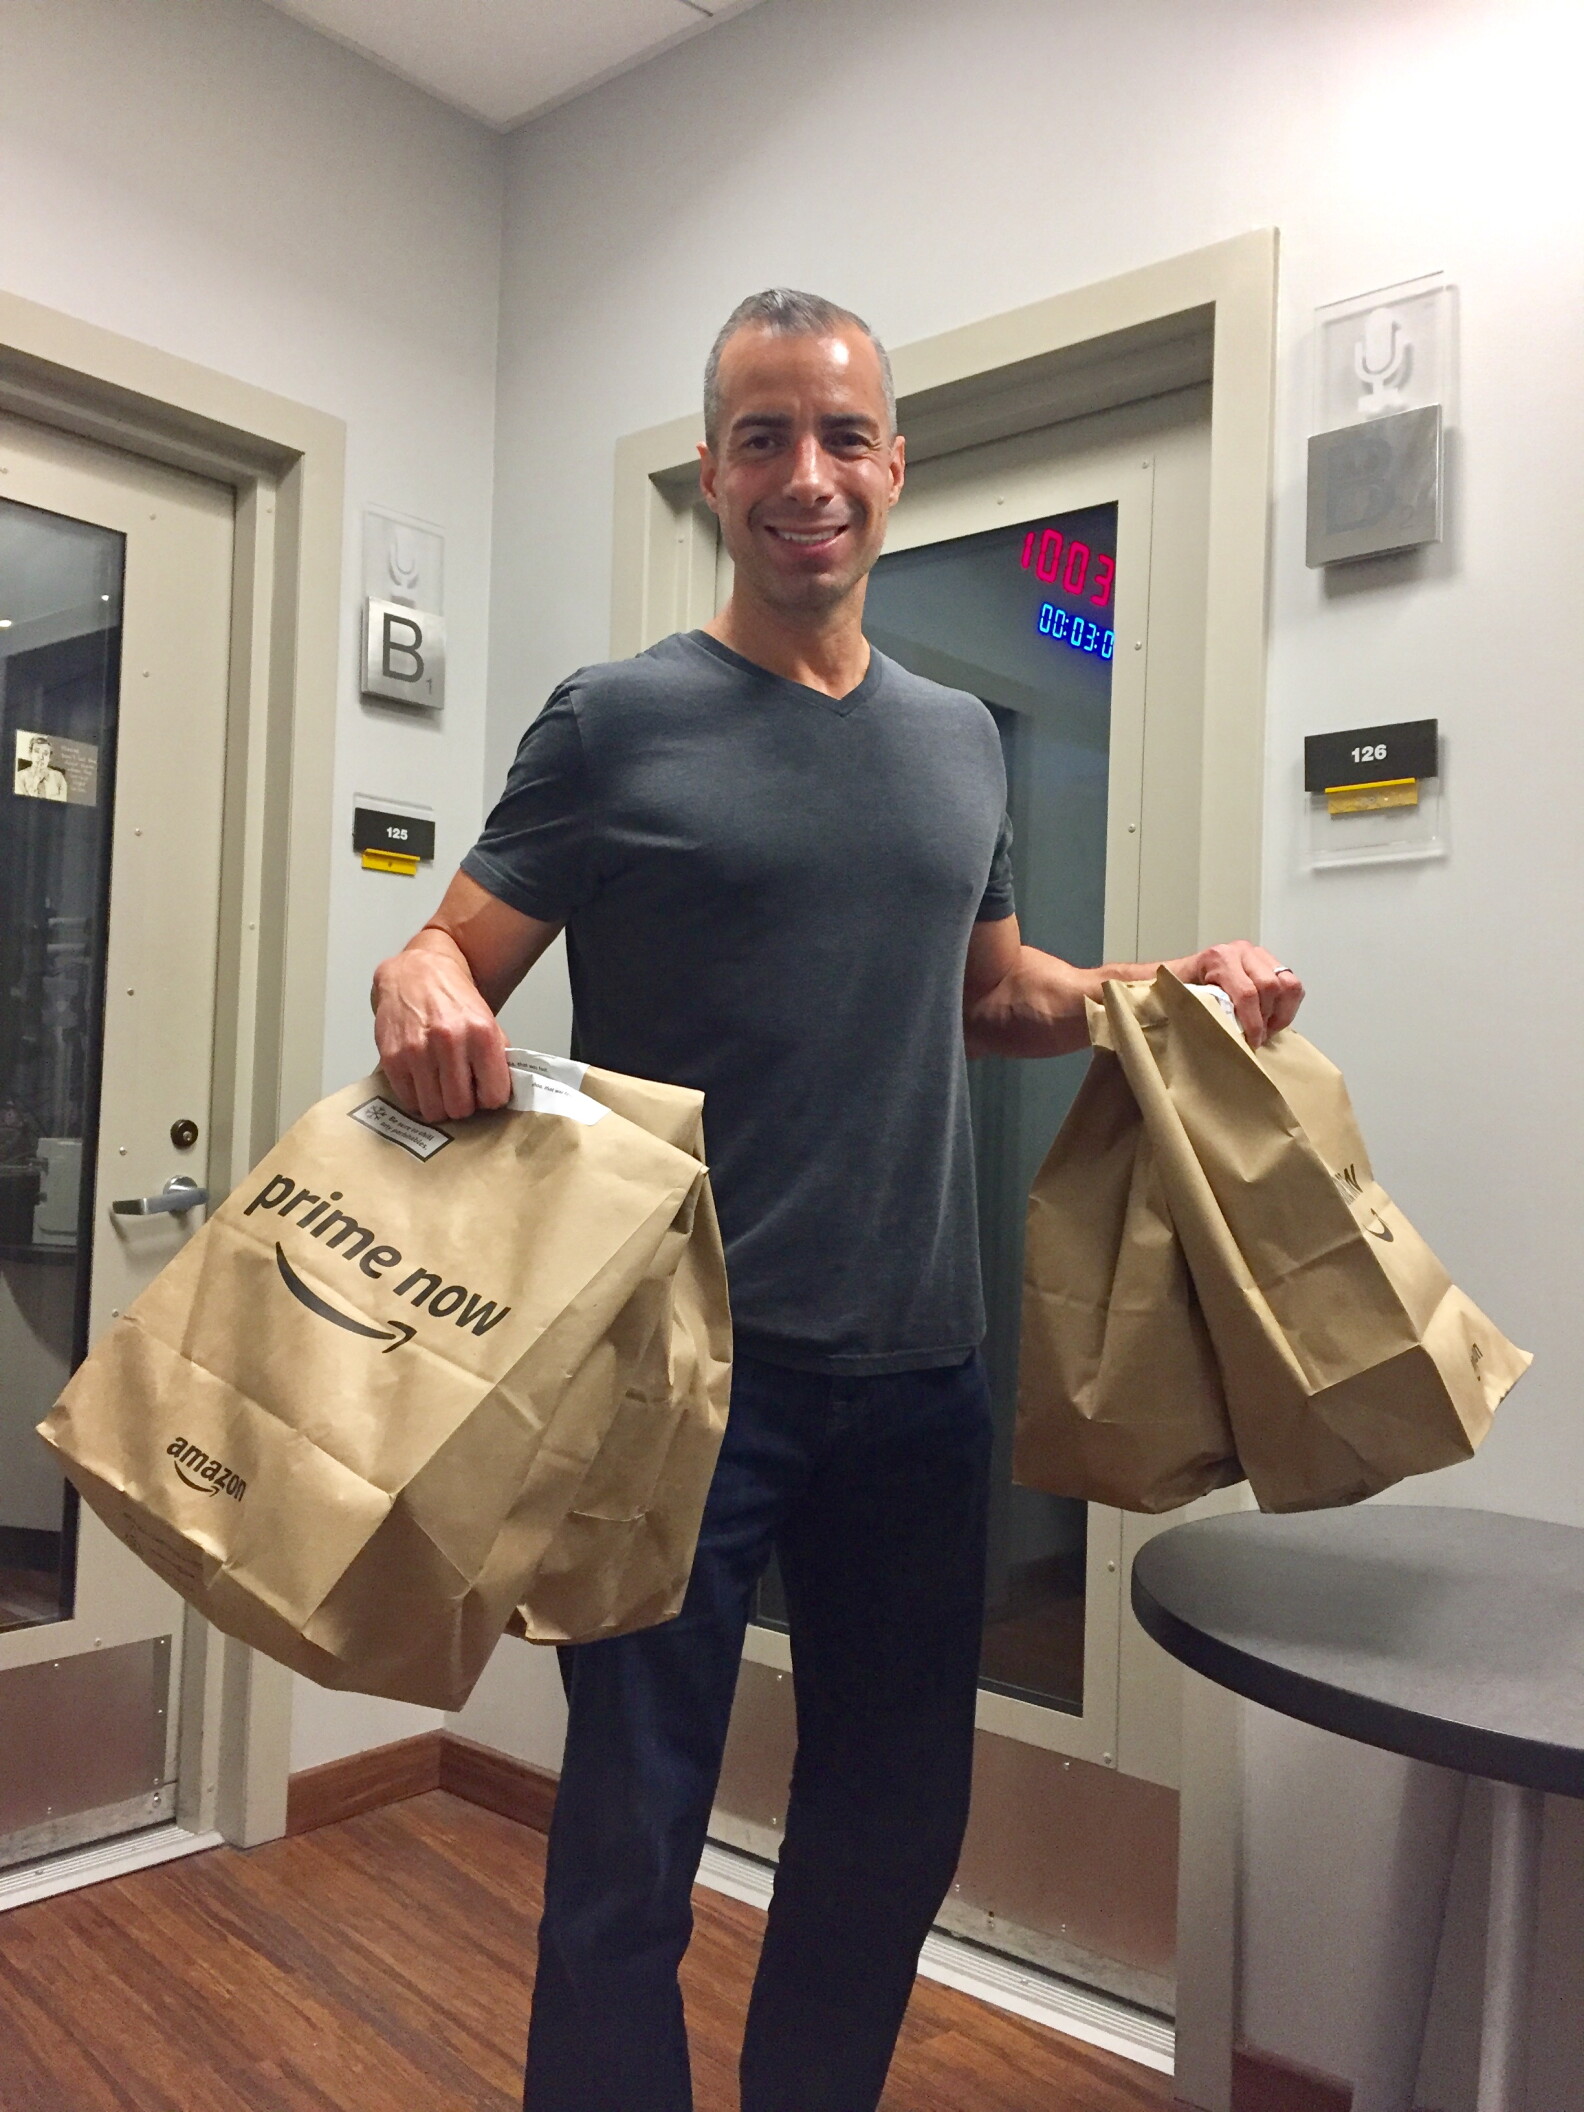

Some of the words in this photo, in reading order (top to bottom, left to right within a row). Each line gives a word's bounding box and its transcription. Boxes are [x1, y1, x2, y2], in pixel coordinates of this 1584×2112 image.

[1326, 437, 1397, 535] B
[382, 612, 425, 683] B
[425, 679, 433, 695] 1
[1351, 743, 1387, 763] 126
[386, 826, 409, 841] 125
[388, 1115, 398, 1124] Be
[418, 1131, 434, 1141] chill
[243, 1173, 403, 1280] prime
[392, 1267, 511, 1337] now
[166, 1436, 247, 1502] amazon
